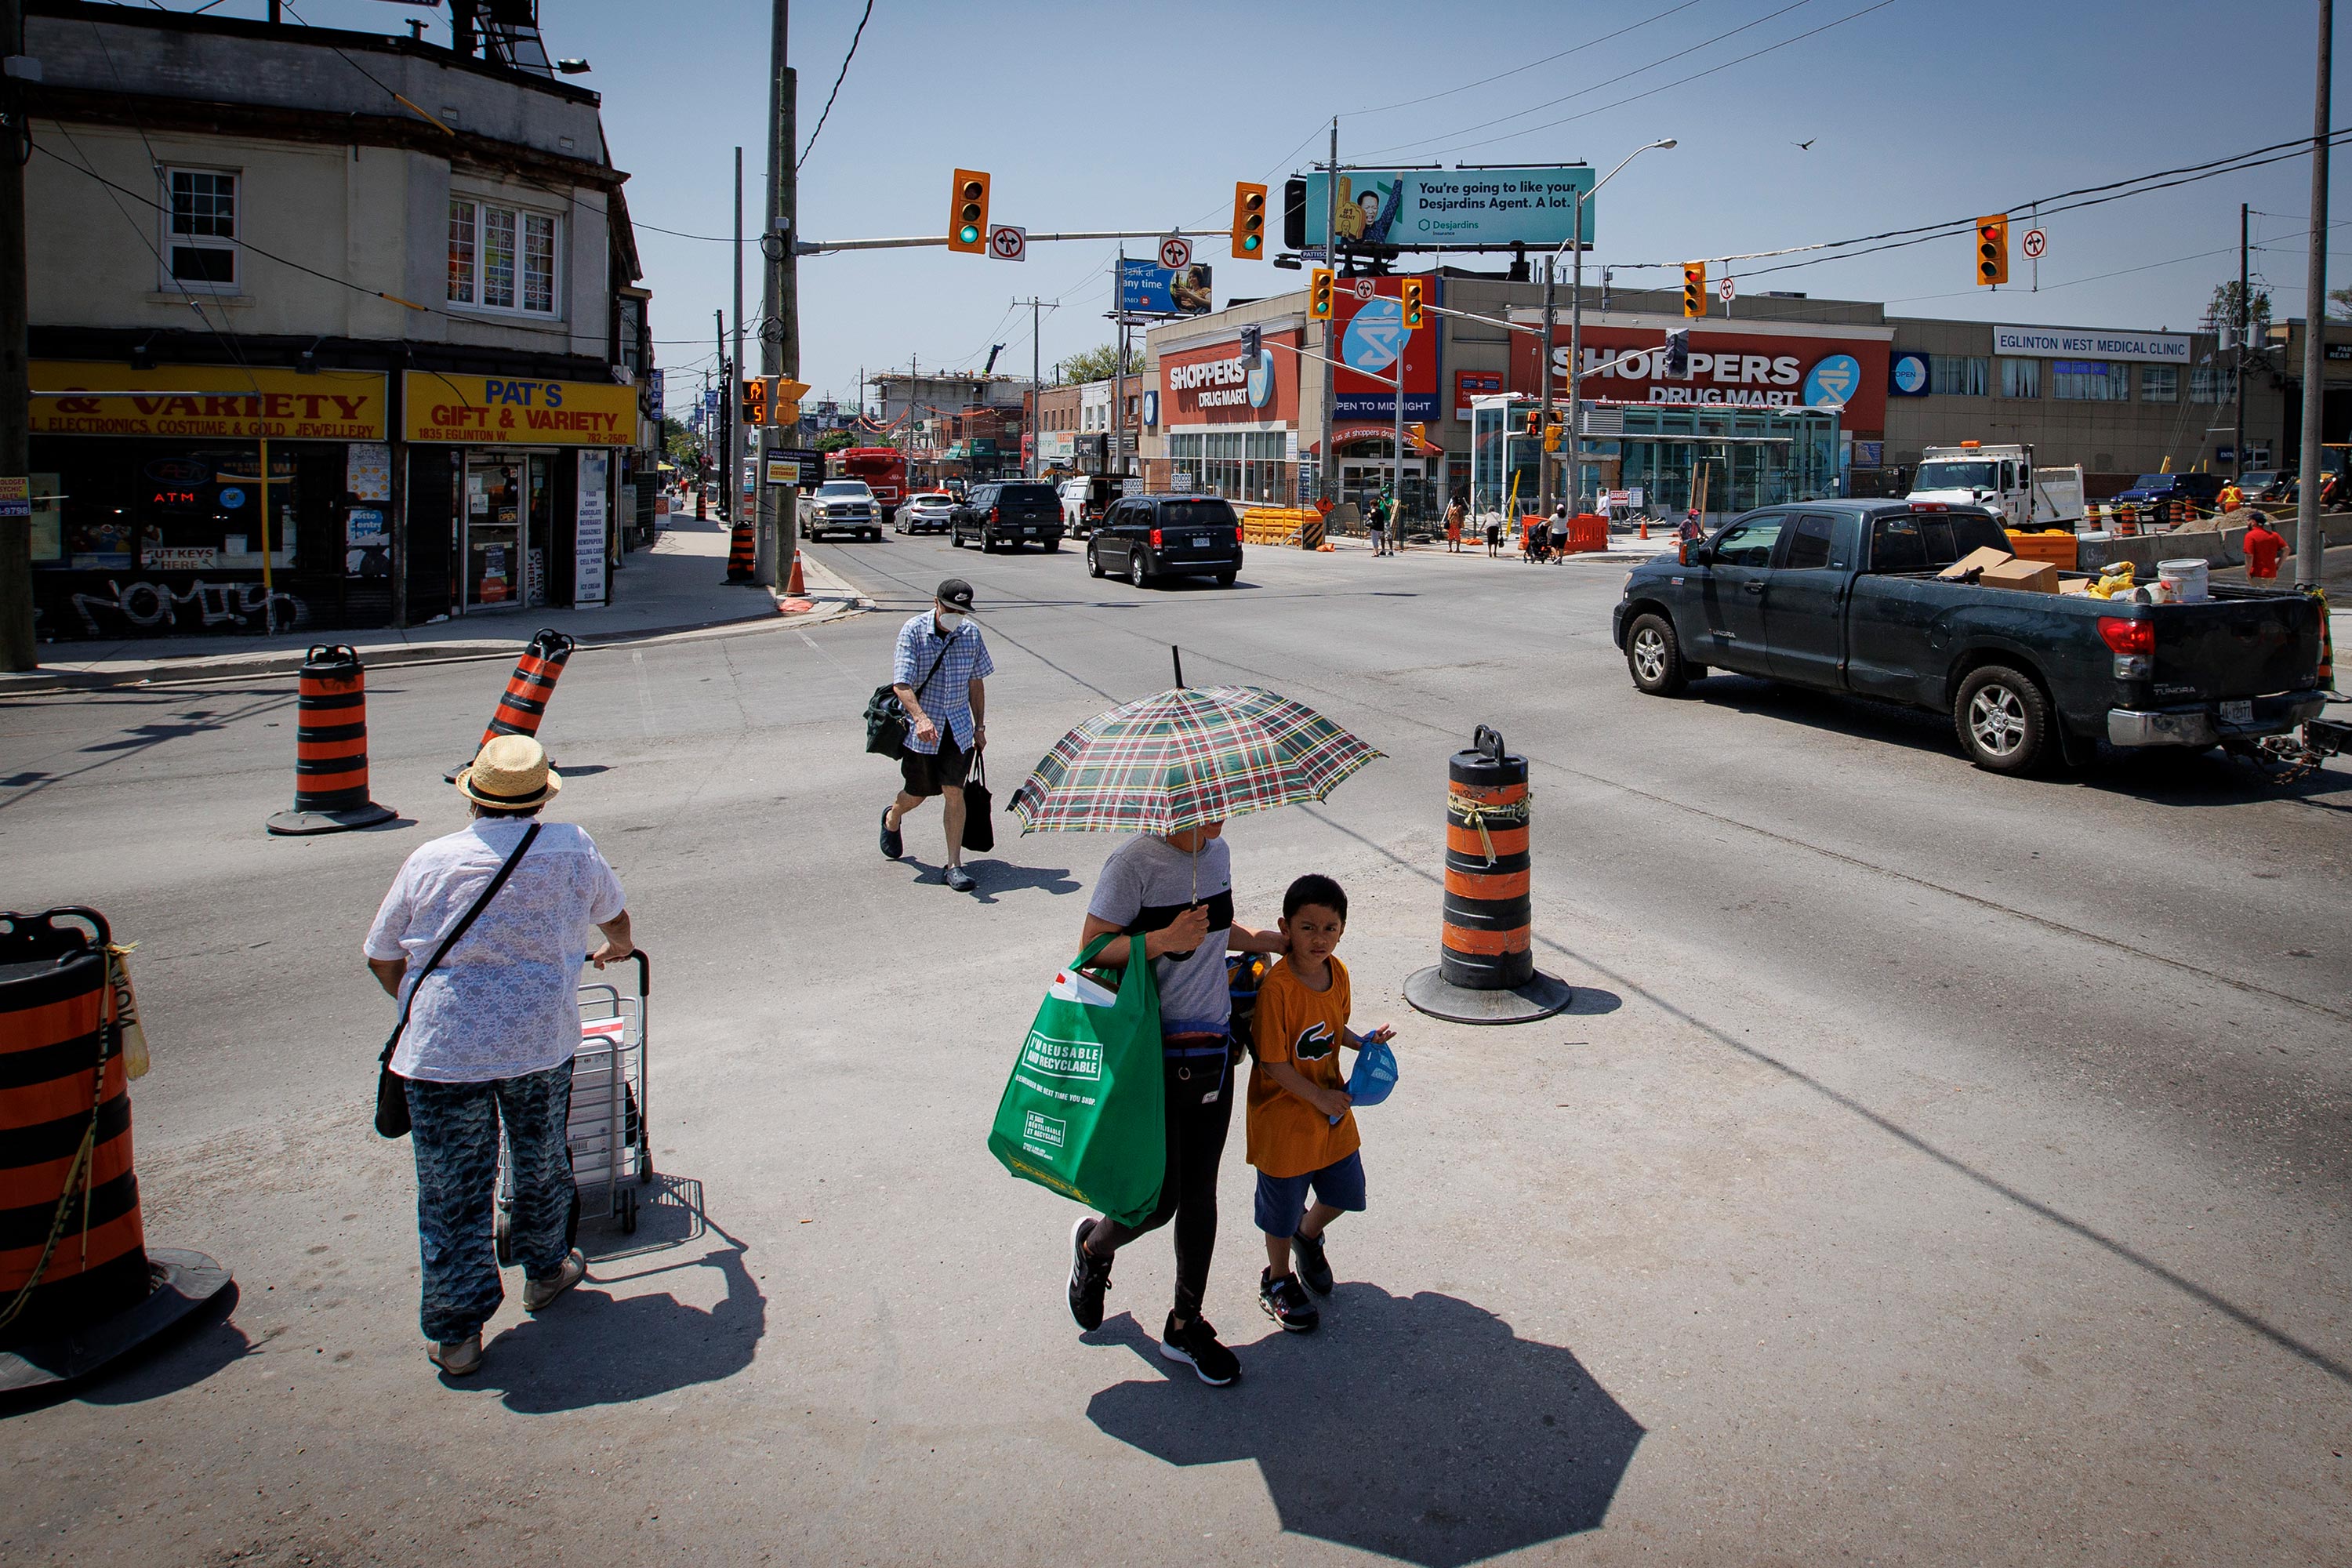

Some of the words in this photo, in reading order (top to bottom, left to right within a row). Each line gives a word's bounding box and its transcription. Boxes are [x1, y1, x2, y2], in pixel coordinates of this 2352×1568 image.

[1418, 182, 1459, 194] You're
[1462, 182, 1500, 196] going
[1503, 183, 1516, 192] to
[1520, 180, 1543, 193] like
[1546, 183, 1576, 195] your
[1418, 198, 1486, 212] Desjardins
[1489, 197, 1532, 211] Agent.
[1535, 197, 1546, 208] A
[1549, 196, 1570, 208] lot.
[1433, 220, 1479, 230] Desjardins
[1123, 267, 1143, 276] Bank
[1123, 280, 1139, 290] any
[1142, 279, 1164, 289] time.
[2000, 335, 2058, 350] EGLINTON
[2062, 337, 2093, 351] WEST
[2097, 339, 2147, 354] MEDICAL
[2149, 343, 2185, 356] CLINIC
[1169, 356, 1246, 391] SHOPPERS
[1552, 346, 1800, 385] SHOPPERS
[485, 380, 563, 408] PAT'S
[1198, 390, 1221, 408] DRUG
[1221, 388, 1247, 406] MART
[1649, 386, 1721, 404] DRUG
[1726, 389, 1798, 406] MART
[56, 387, 101, 414] &
[128, 389, 368, 419] VARIETY
[1335, 401, 1357, 411] PEN
[1359, 401, 1375, 411] TO
[431, 405, 490, 426] GIFT
[498, 408, 515, 428] &
[525, 409, 619, 431] VARIETY
[753, 406, 762, 422] 5
[49, 417, 151, 434] ELECTRONICS,
[158, 420, 227, 436] COSTUME
[233, 421, 242, 435] &
[249, 422, 285, 436] GOLD
[296, 423, 375, 438] JEWELLERY
[419, 428, 442, 439] 1835
[445, 429, 496, 441] EGLINTON
[497, 430, 510, 441] W.
[1352, 430, 1380, 439] shoppers
[1381, 430, 1396, 440] drug
[1123, 479, 1143, 488] STUCCO
[153, 492, 194, 503] ATM
[177, 549, 213, 558] KEYS
[161, 560, 198, 569] HERE
[2153, 686, 2196, 695] TUNDRA
[1030, 1036, 1043, 1051] I'M
[1041, 1042, 1098, 1061] REUSABLE
[1026, 1049, 1040, 1065] AND
[1039, 1054, 1097, 1074] RECYCLABLE
[1014, 1073, 1037, 1090] REMEMBER
[1036, 1083, 1044, 1093] ME
[1043, 1087, 1054, 1098] NEXT
[1054, 1091, 1068, 1101] TIME
[1069, 1094, 1081, 1103] YOU
[1081, 1096, 1096, 1106] SHOP.
[1033, 1129, 1061, 1144] RECYCLABLE
